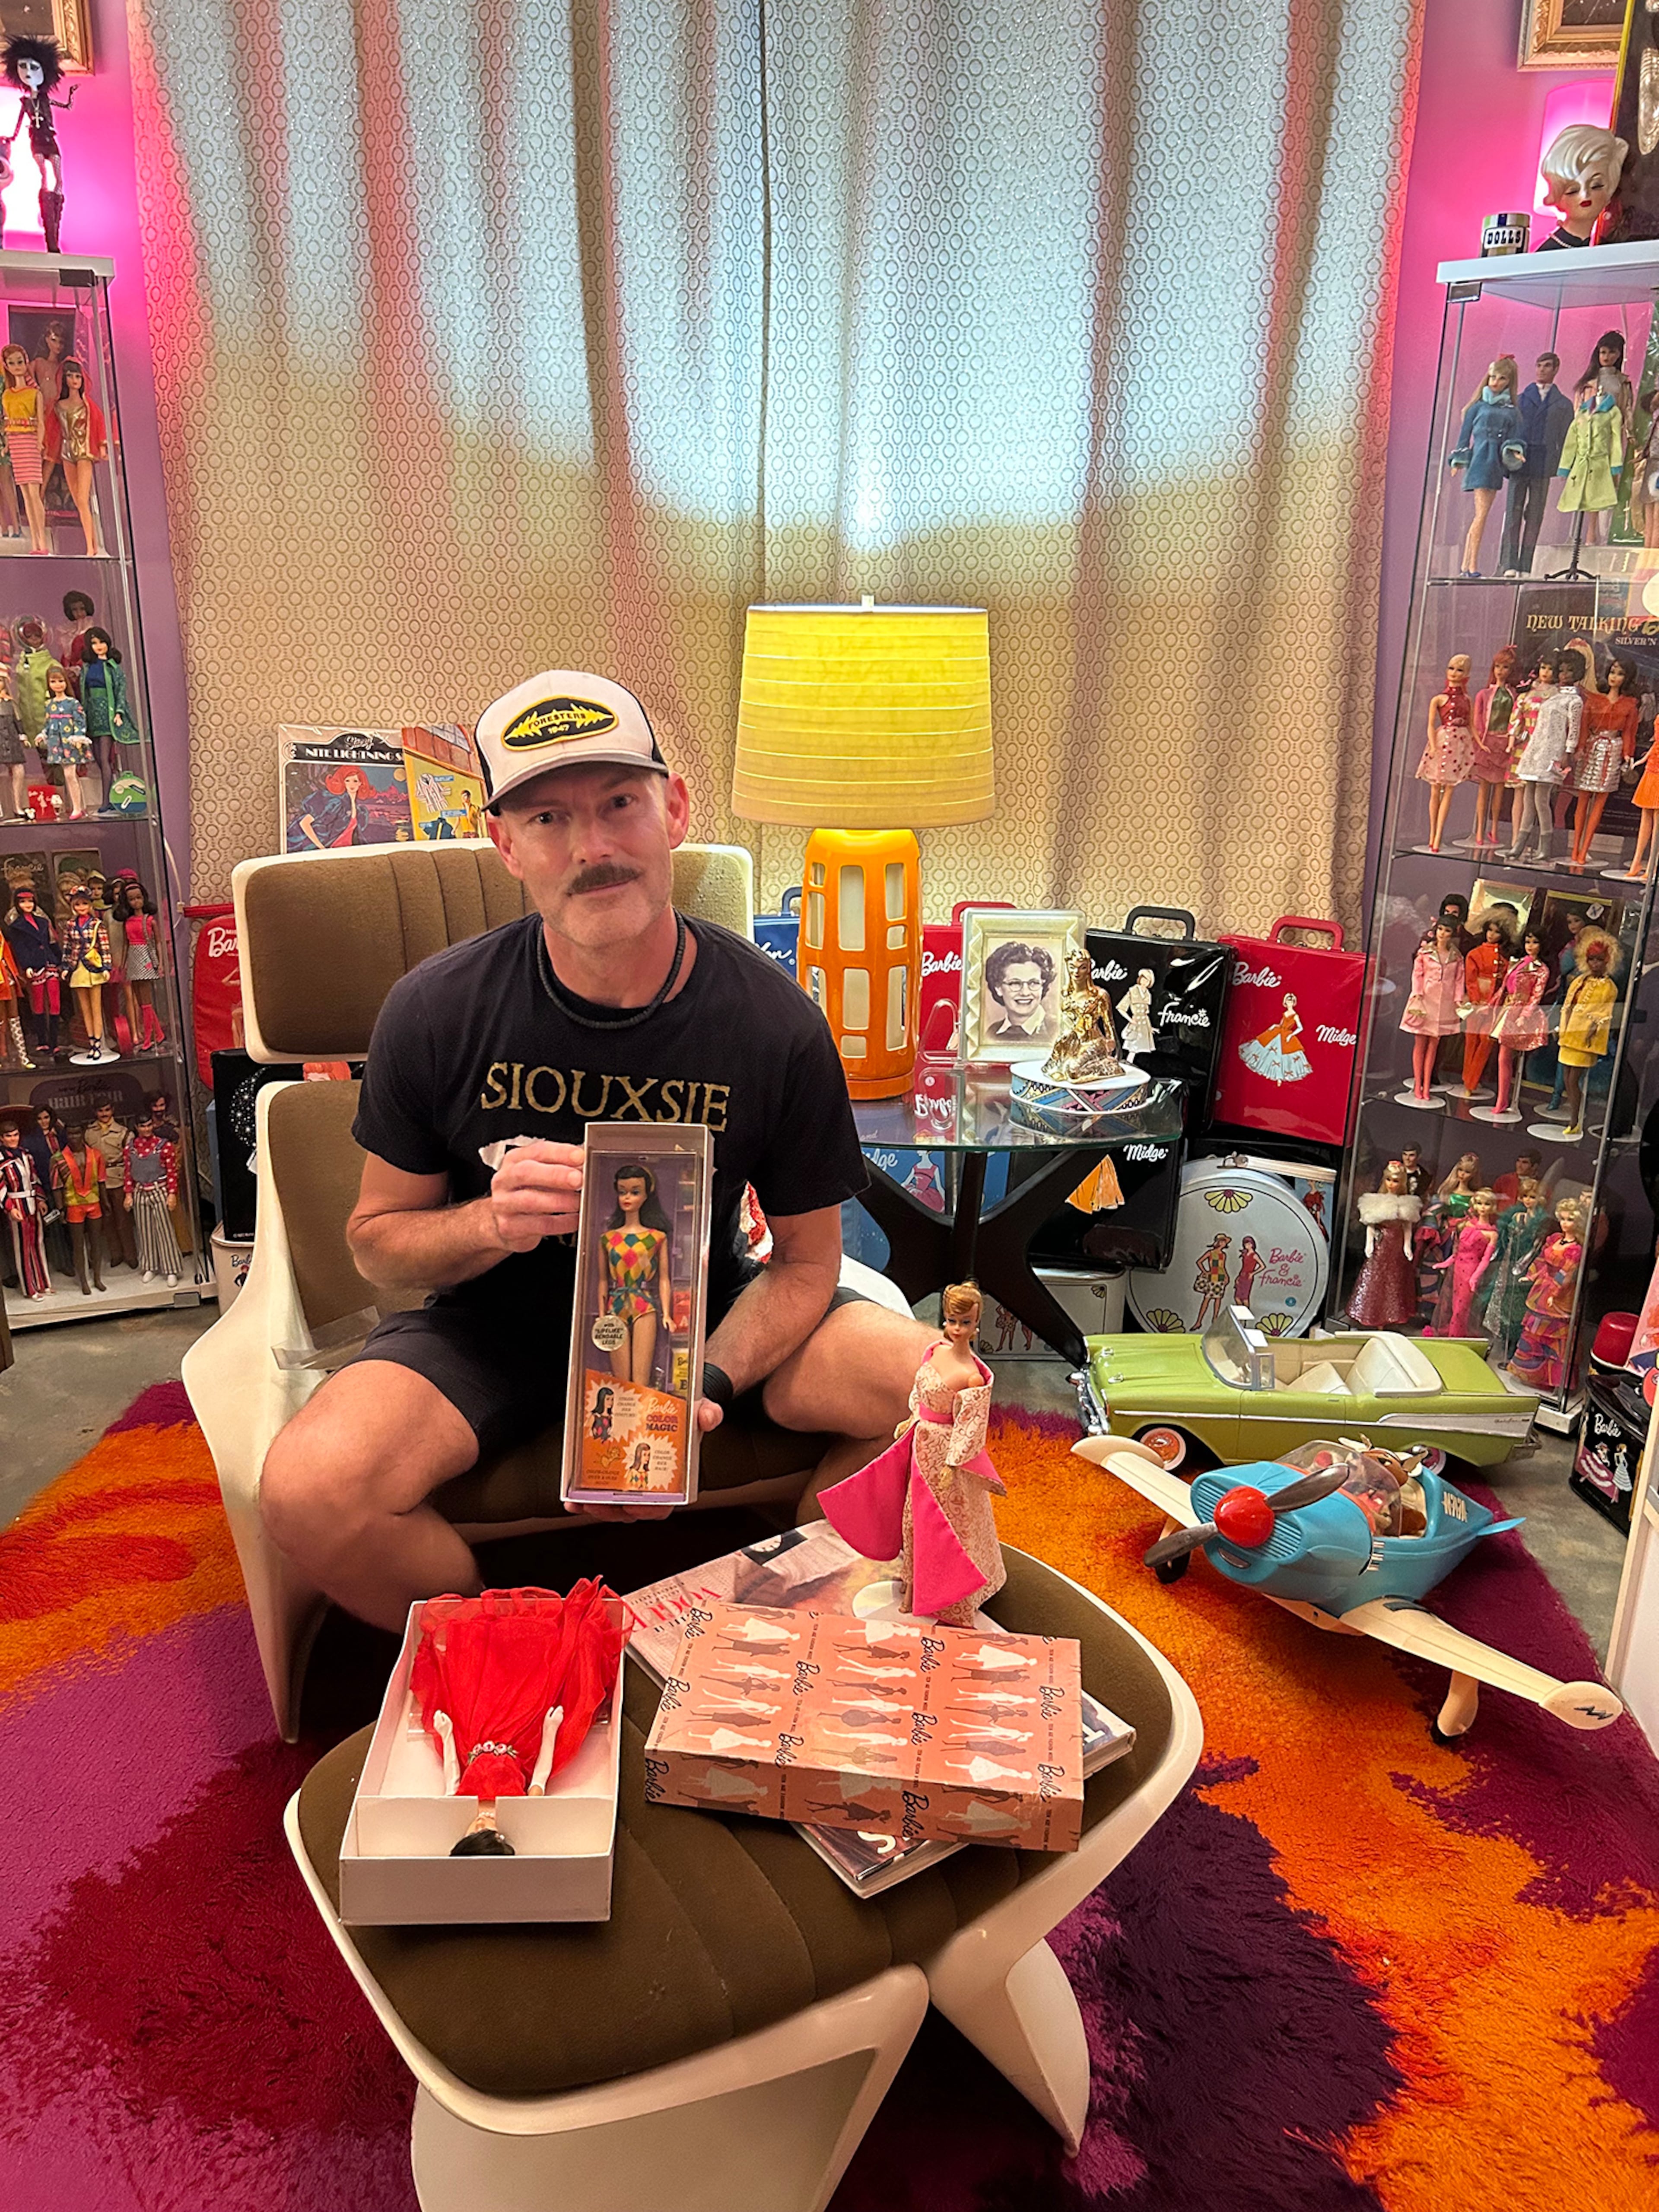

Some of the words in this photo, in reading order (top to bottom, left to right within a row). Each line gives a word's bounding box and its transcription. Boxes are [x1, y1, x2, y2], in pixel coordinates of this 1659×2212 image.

[1487, 230, 1521, 245] DOLLS
[1527, 614, 1563, 632] NEW
[1615, 636, 1647, 645] SILVER
[528, 713, 586, 729] FORESTERS
[548, 724, 570, 734] 1947
[333, 750, 393, 761] LIGHTNING
[394, 752, 405, 761] S
[921, 950, 962, 977] Barbie
[1232, 961, 1281, 987] Barbie
[1157, 1001, 1210, 1027] Francie
[1316, 1024, 1357, 1046] Midge
[480, 1062, 731, 1132] SIOUXSIE
[1123, 1144, 1167, 1162] Midge
[1269, 1247, 1304, 1264] Barbie
[1259, 1269, 1303, 1287] Francie
[1278, 1262, 1290, 1277] &
[679, 1316, 688, 1327] A
[647, 1397, 678, 1414] Barbie
[646, 1414, 678, 1424] COLOR
[646, 1423, 677, 1432] MAGIC
[1594, 1413, 1621, 1437] Barbie
[685, 1608, 712, 1639] Barbie
[921, 1637, 945, 1672] Barbie
[793, 1660, 820, 1696] Barbie
[660, 1677, 690, 1712] Barbie
[1039, 1685, 1065, 1720] Barbie
[911, 1712, 938, 1745] Barbie
[775, 1733, 804, 1768] Barbie
[644, 1758, 669, 1802] Barbie
[1038, 1763, 1065, 1803] Barbie
[902, 1790, 929, 1837] Barbie
